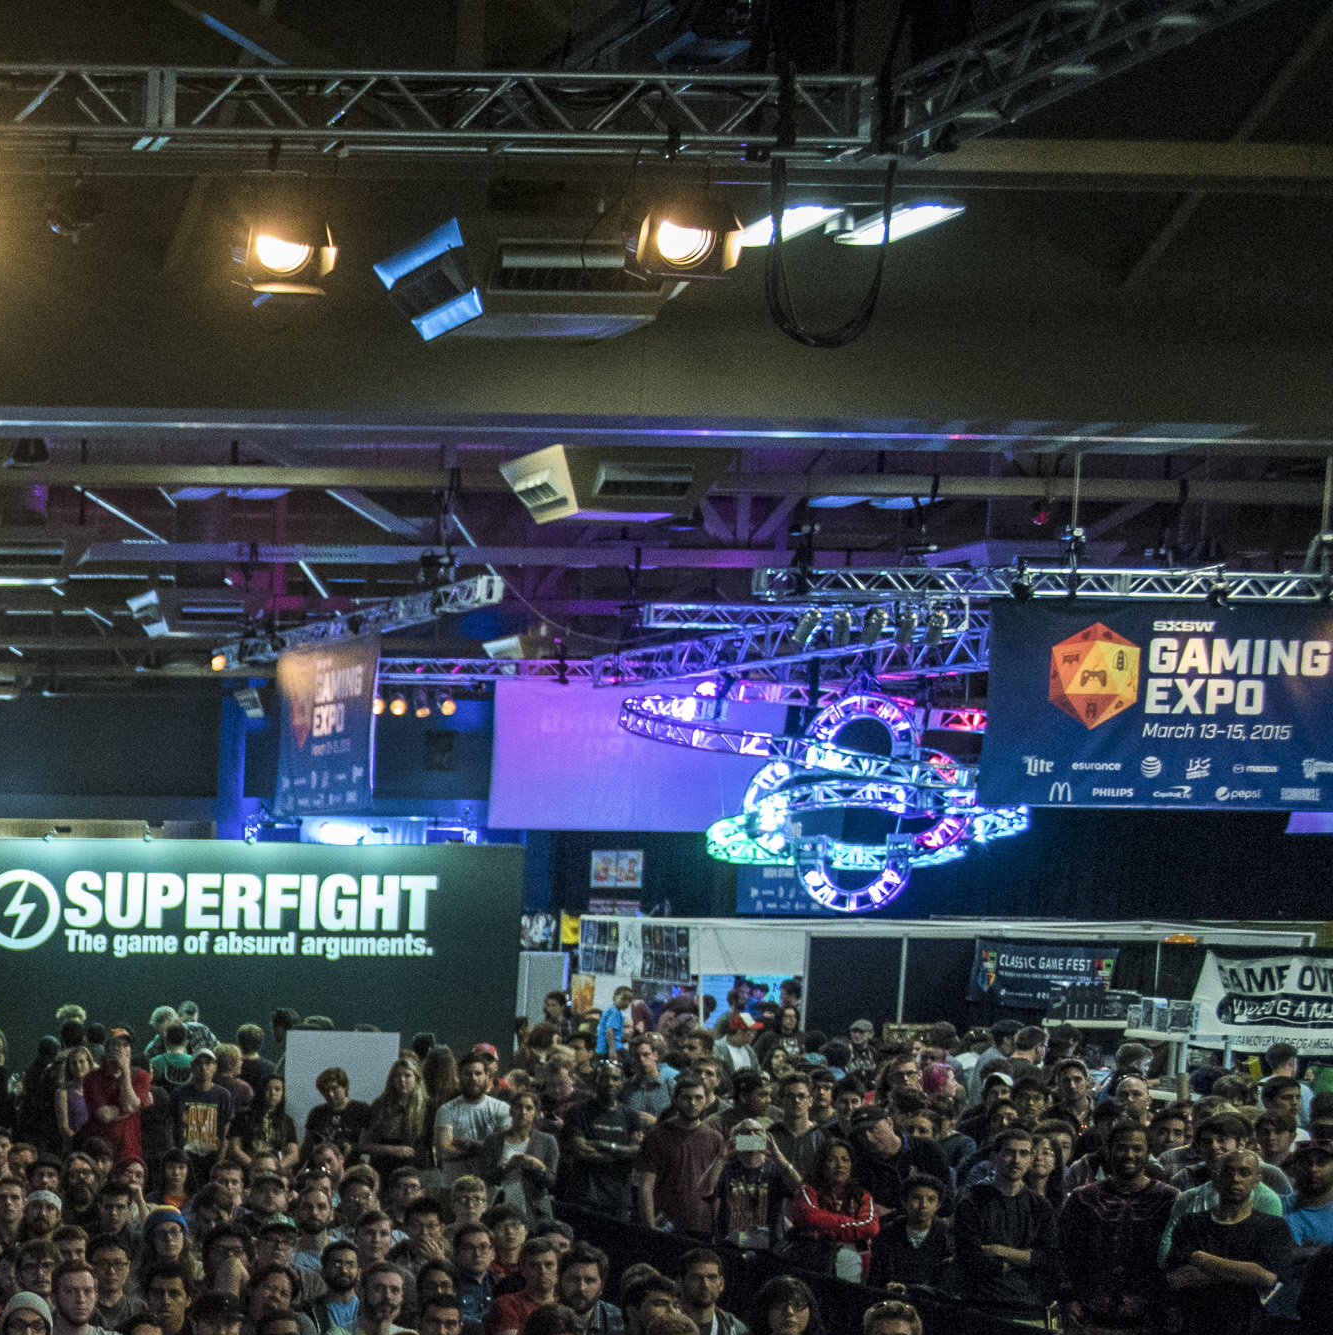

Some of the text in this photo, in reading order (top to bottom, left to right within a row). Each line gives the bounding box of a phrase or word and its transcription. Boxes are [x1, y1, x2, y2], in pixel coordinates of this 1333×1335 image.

[1153, 621, 1216, 632] SXSW
[1148, 637, 1332, 676] GAMING
[1145, 678, 1265, 715] EXPO
[1142, 723, 1194, 739] March
[1250, 725, 1292, 740] 2015
[1071, 761, 1122, 771] esurance
[1092, 788, 1134, 797] PHILIPS
[1231, 789, 1261, 800] pepsi
[64, 870, 437, 931] SUPERFIGHT
[65, 930, 434, 960] The game of absurd arguments.
[999, 953, 1092, 972] CLASSIC GAME FEST
